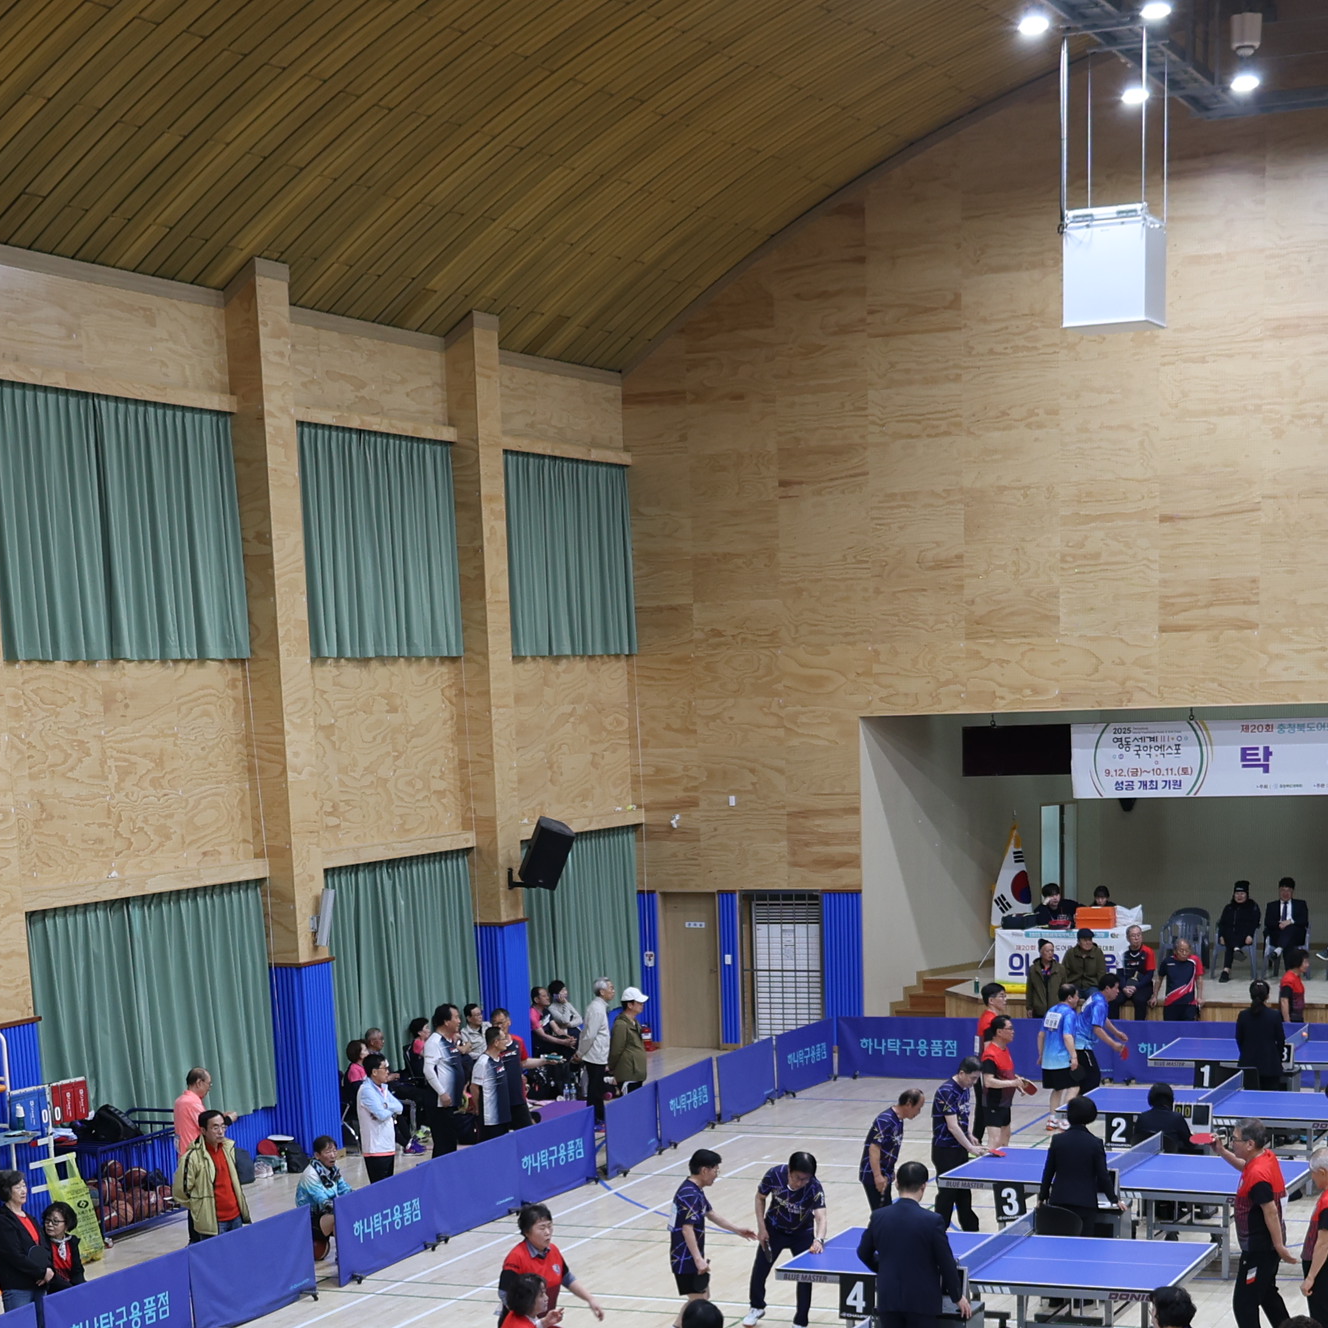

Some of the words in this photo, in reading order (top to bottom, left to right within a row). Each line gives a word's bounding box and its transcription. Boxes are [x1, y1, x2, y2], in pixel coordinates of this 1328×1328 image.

[1112, 726, 1132, 735] 2025
[1240, 723, 1274, 734] 제20회
[1239, 745, 1273, 774] 탁
[1114, 780, 1135, 791] 성공
[1138, 780, 1159, 791] 개최
[1161, 779, 1182, 790] 기원
[859, 1037, 958, 1058] 하나탁구용품점
[1199, 1064, 1211, 1087] 1
[668, 1084, 709, 1118] 하나탁구용품점
[1111, 1117, 1127, 1143] 2
[521, 1138, 585, 1176] 하나탁구용품점
[961, 1181, 984, 1189] MASTER
[1000, 1187, 1020, 1216] 3
[353, 1197, 422, 1243] 하나탁구용품점
[783, 1273, 800, 1281] BLUE
[801, 1274, 828, 1282] MASTER
[845, 1281, 866, 1313] 4
